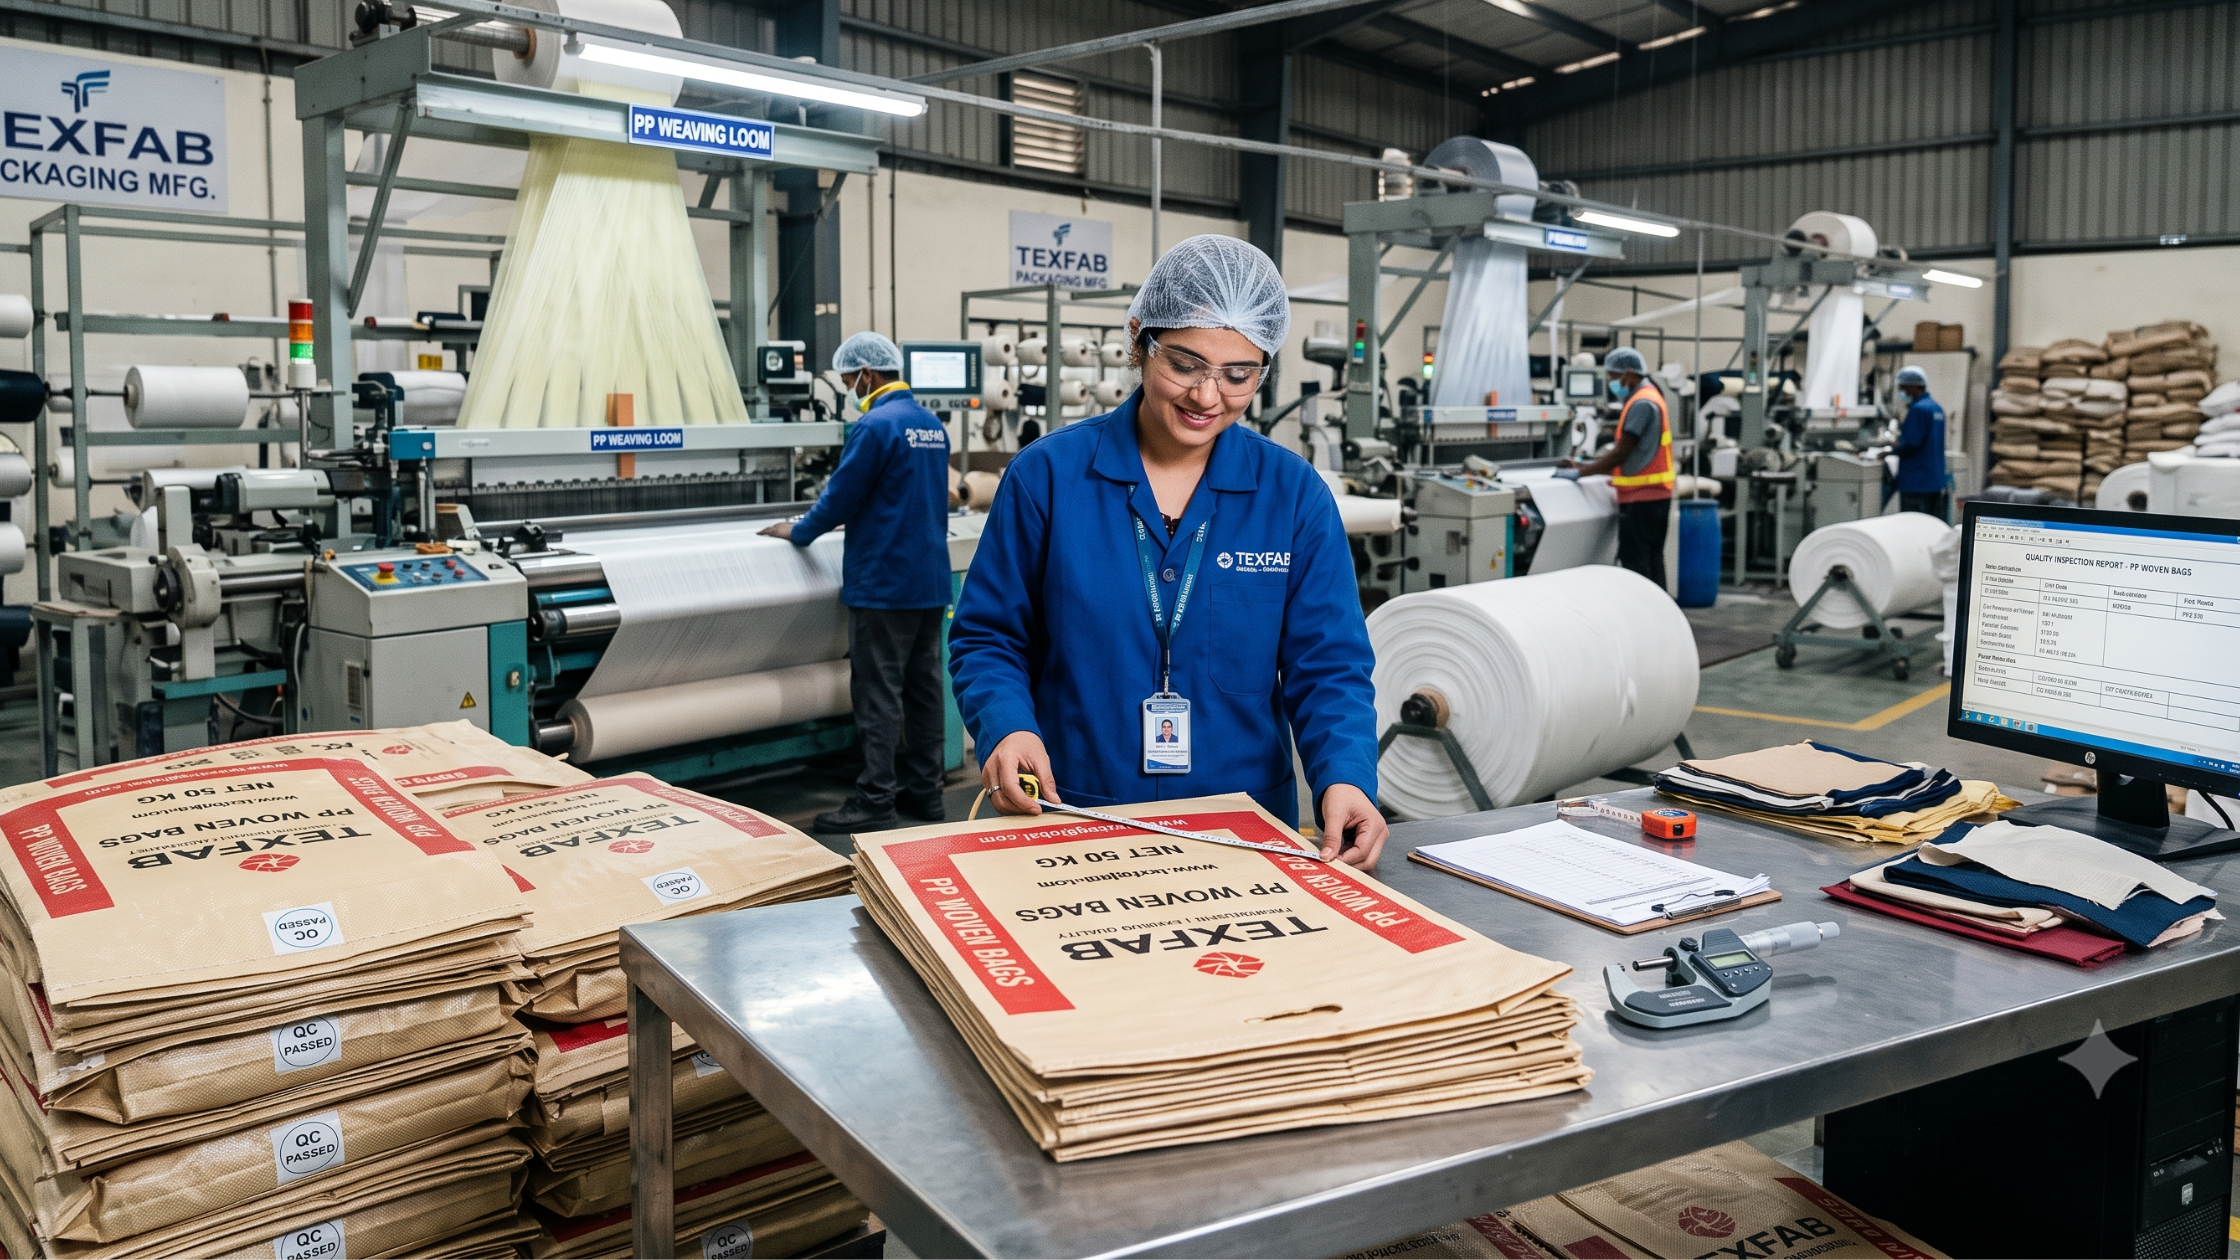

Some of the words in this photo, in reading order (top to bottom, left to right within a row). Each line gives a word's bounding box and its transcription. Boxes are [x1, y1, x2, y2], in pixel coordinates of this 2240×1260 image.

[633, 113, 656, 135] PP
[657, 116, 727, 145] WEAVING
[729, 126, 770, 150] LOOM
[149, 171, 216, 200] MFG.
[1016, 245, 1108, 273] TEXFAB
[1015, 270, 1081, 287] PACKAGING
[593, 434, 607, 447] PP
[608, 433, 652, 446] WEAVING
[654, 432, 682, 445] LOOM
[1235, 551, 1291, 566] TEXFAB
[2025, 552, 2053, 563] QUALITY
[2054, 555, 2094, 567] INSPECTION
[2095, 560, 2124, 570] REPORT
[2129, 562, 2140, 571] PP
[2140, 563, 2169, 574] WOVEN
[2171, 566, 2192, 576] BAGS
[183, 786, 217, 798] 50
[225, 781, 275, 794] NET
[137, 791, 176, 805] KG
[193, 810, 310, 832] WOVEN
[317, 807, 355, 818] PP
[551, 807, 638, 829] WOVEN
[18, 823, 54, 840] PP
[98, 825, 185, 848] BAGS
[482, 824, 547, 847] BAGS
[518, 815, 700, 858] TEXFAB
[127, 826, 372, 870] TEXFAB
[1084, 850, 1121, 863] 50
[1128, 844, 1186, 859] NET
[1036, 855, 1080, 868] KG
[920, 877, 960, 896] PP
[1249, 882, 1291, 896] PP
[1302, 874, 1380, 912] WOVEN
[1116, 886, 1243, 911] WOVEN
[1015, 900, 1111, 922] BAGS
[1363, 911, 1411, 928] PP
[278, 916, 326, 930] PASSED
[935, 897, 1001, 946] WOVEN
[1061, 916, 1329, 961] TEXFAB
[972, 948, 1035, 987] BAGS
[293, 1023, 318, 1038] QC
[284, 1037, 333, 1056] PASSED
[295, 1130, 321, 1147] QC
[286, 1143, 335, 1165] PASSED
[296, 1229, 322, 1246] QC
[717, 1233, 737, 1248] QC
